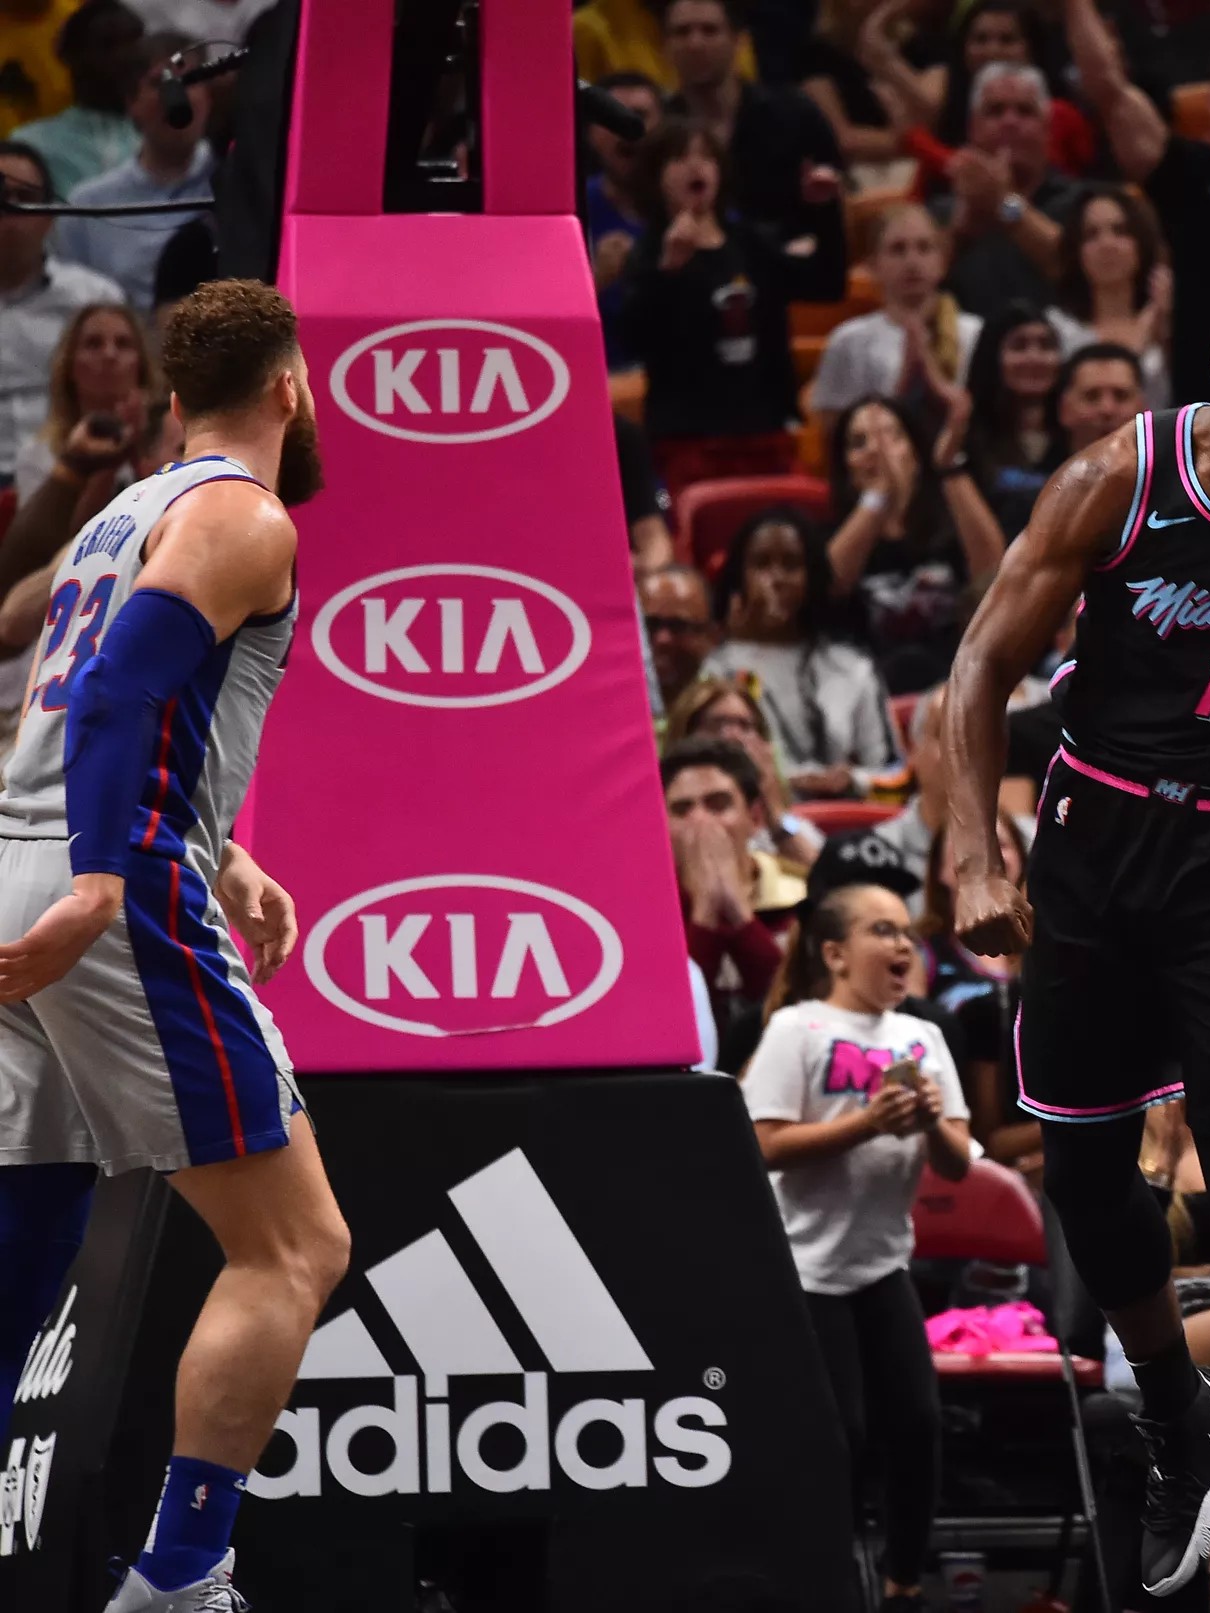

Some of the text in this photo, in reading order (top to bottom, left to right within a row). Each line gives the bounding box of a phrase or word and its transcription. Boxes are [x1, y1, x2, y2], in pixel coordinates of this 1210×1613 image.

[371, 347, 531, 415] KIA
[25, 573, 119, 714] 23
[360, 597, 546, 674] KIA
[357, 912, 572, 1000] KIA
[245, 1372, 732, 1500] adidas
